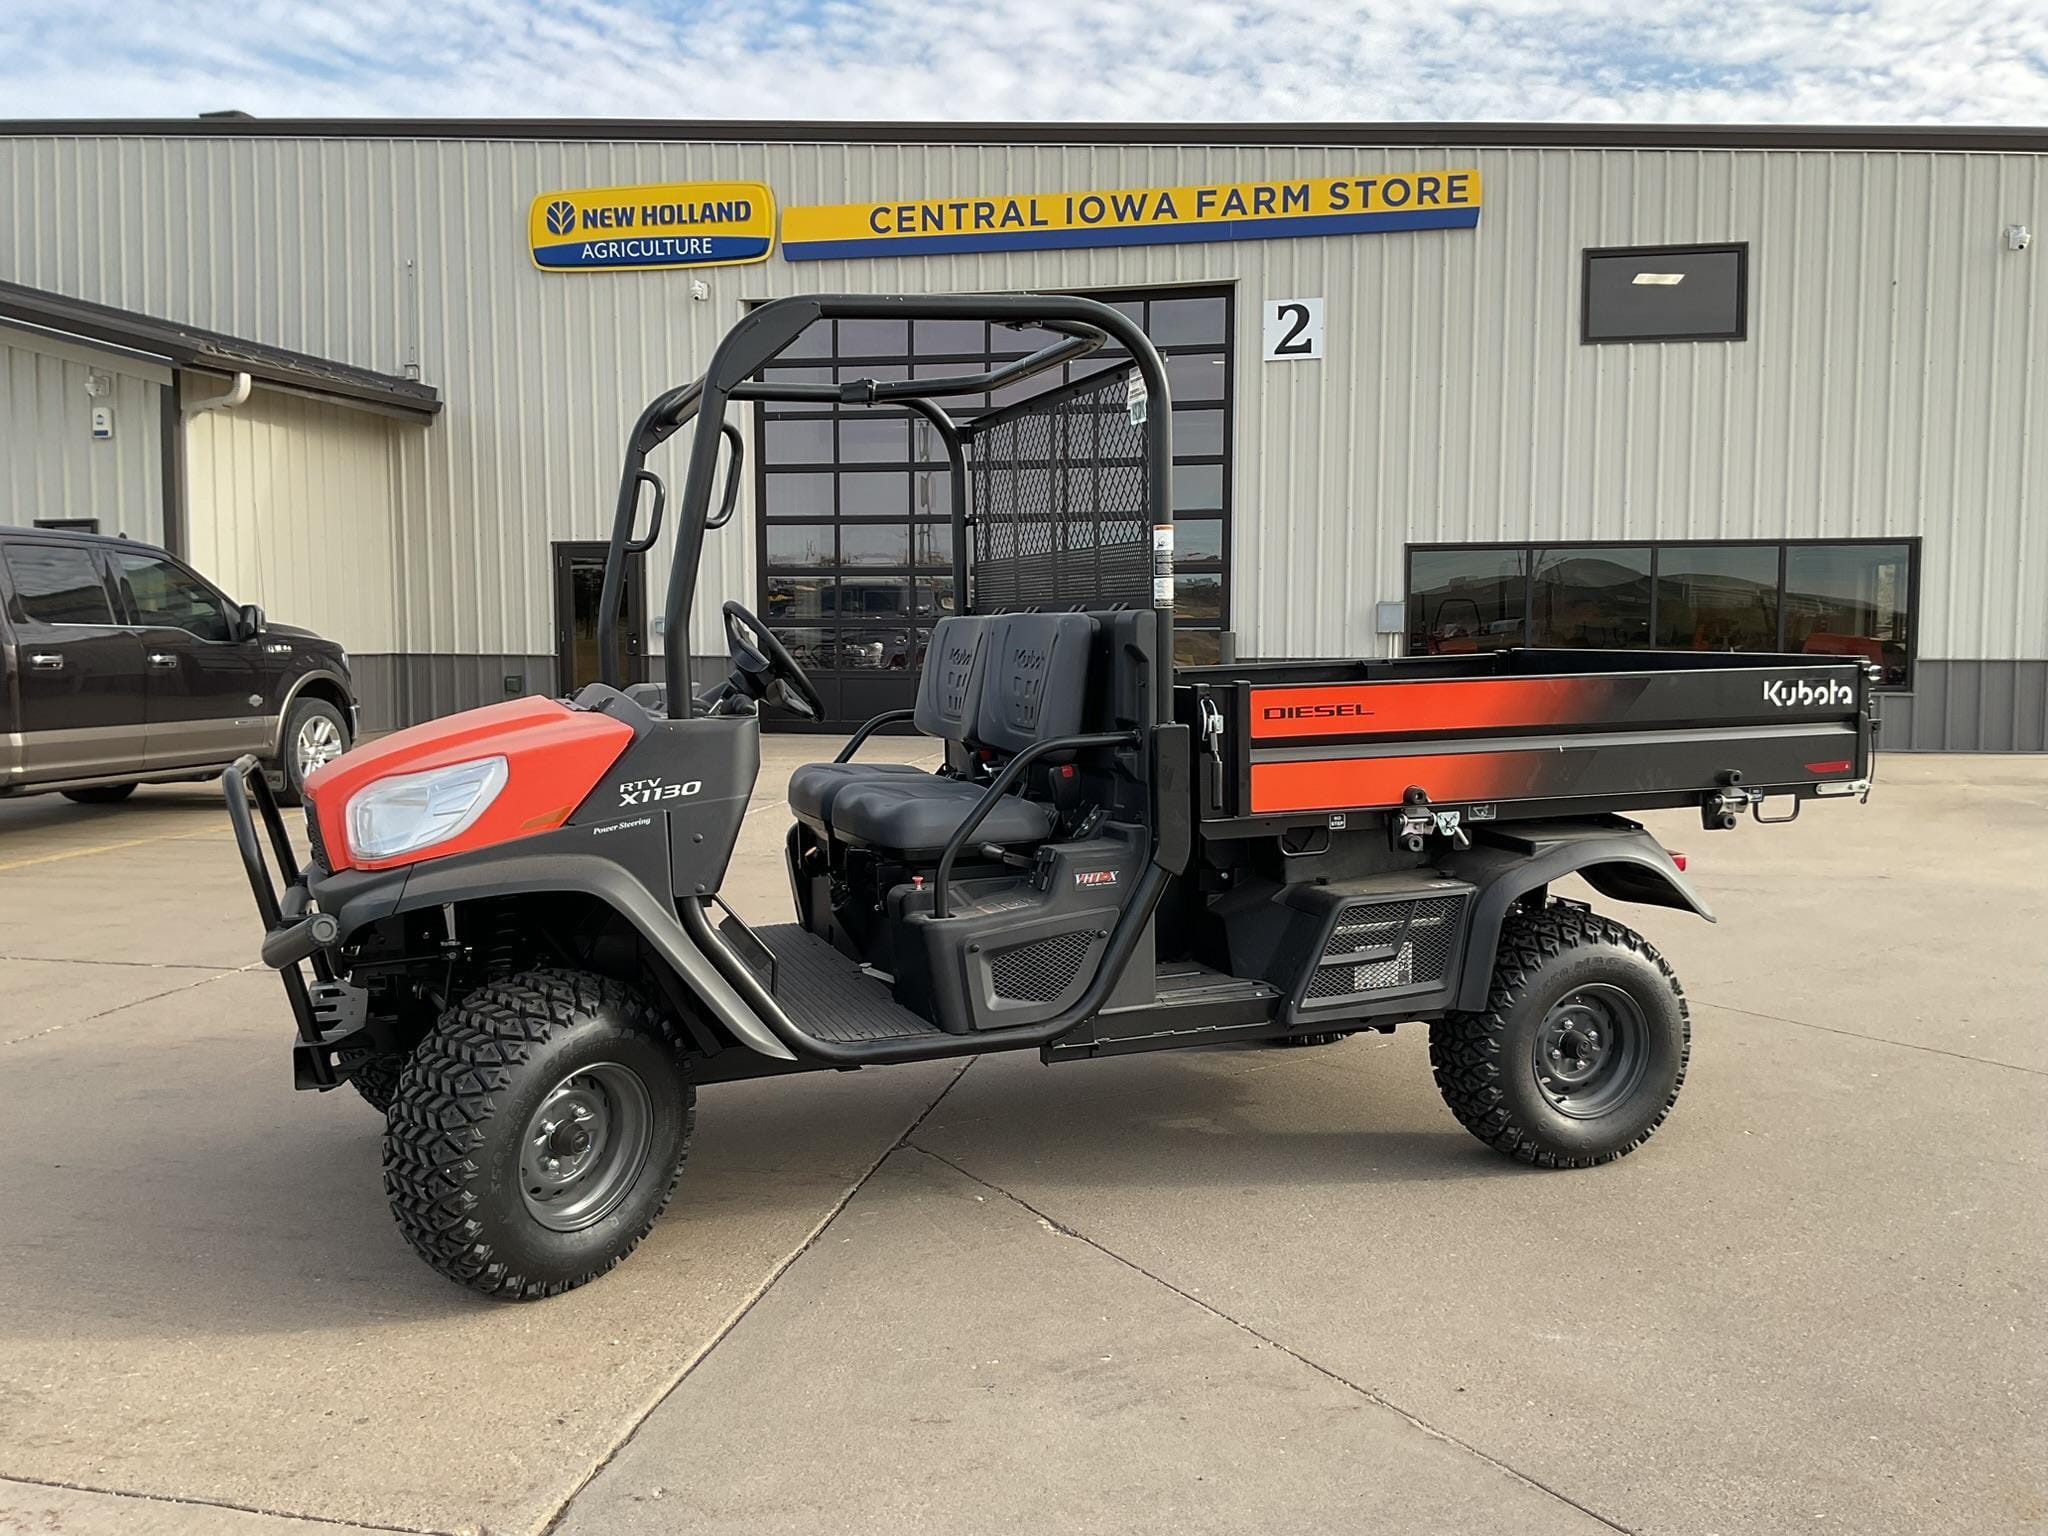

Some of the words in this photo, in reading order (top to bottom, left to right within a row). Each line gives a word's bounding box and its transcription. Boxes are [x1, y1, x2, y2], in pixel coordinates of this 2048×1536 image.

[582, 205, 636, 230] NEW
[641, 200, 751, 226] HOLLAND
[869, 199, 1049, 234] CENTRAL
[1065, 192, 1178, 225] IOWA
[1197, 184, 1310, 218] FARM
[1328, 174, 1470, 210] STORE
[582, 238, 713, 260] AGRICULTURE
[1274, 303, 1313, 356] 2
[1763, 679, 1853, 707] Kubota
[1263, 703, 1375, 720] DIESEL
[618, 781, 702, 807] X1130
[619, 777, 662, 793] RTV
[593, 824, 618, 835] Power
[619, 817, 651, 829] Steering
